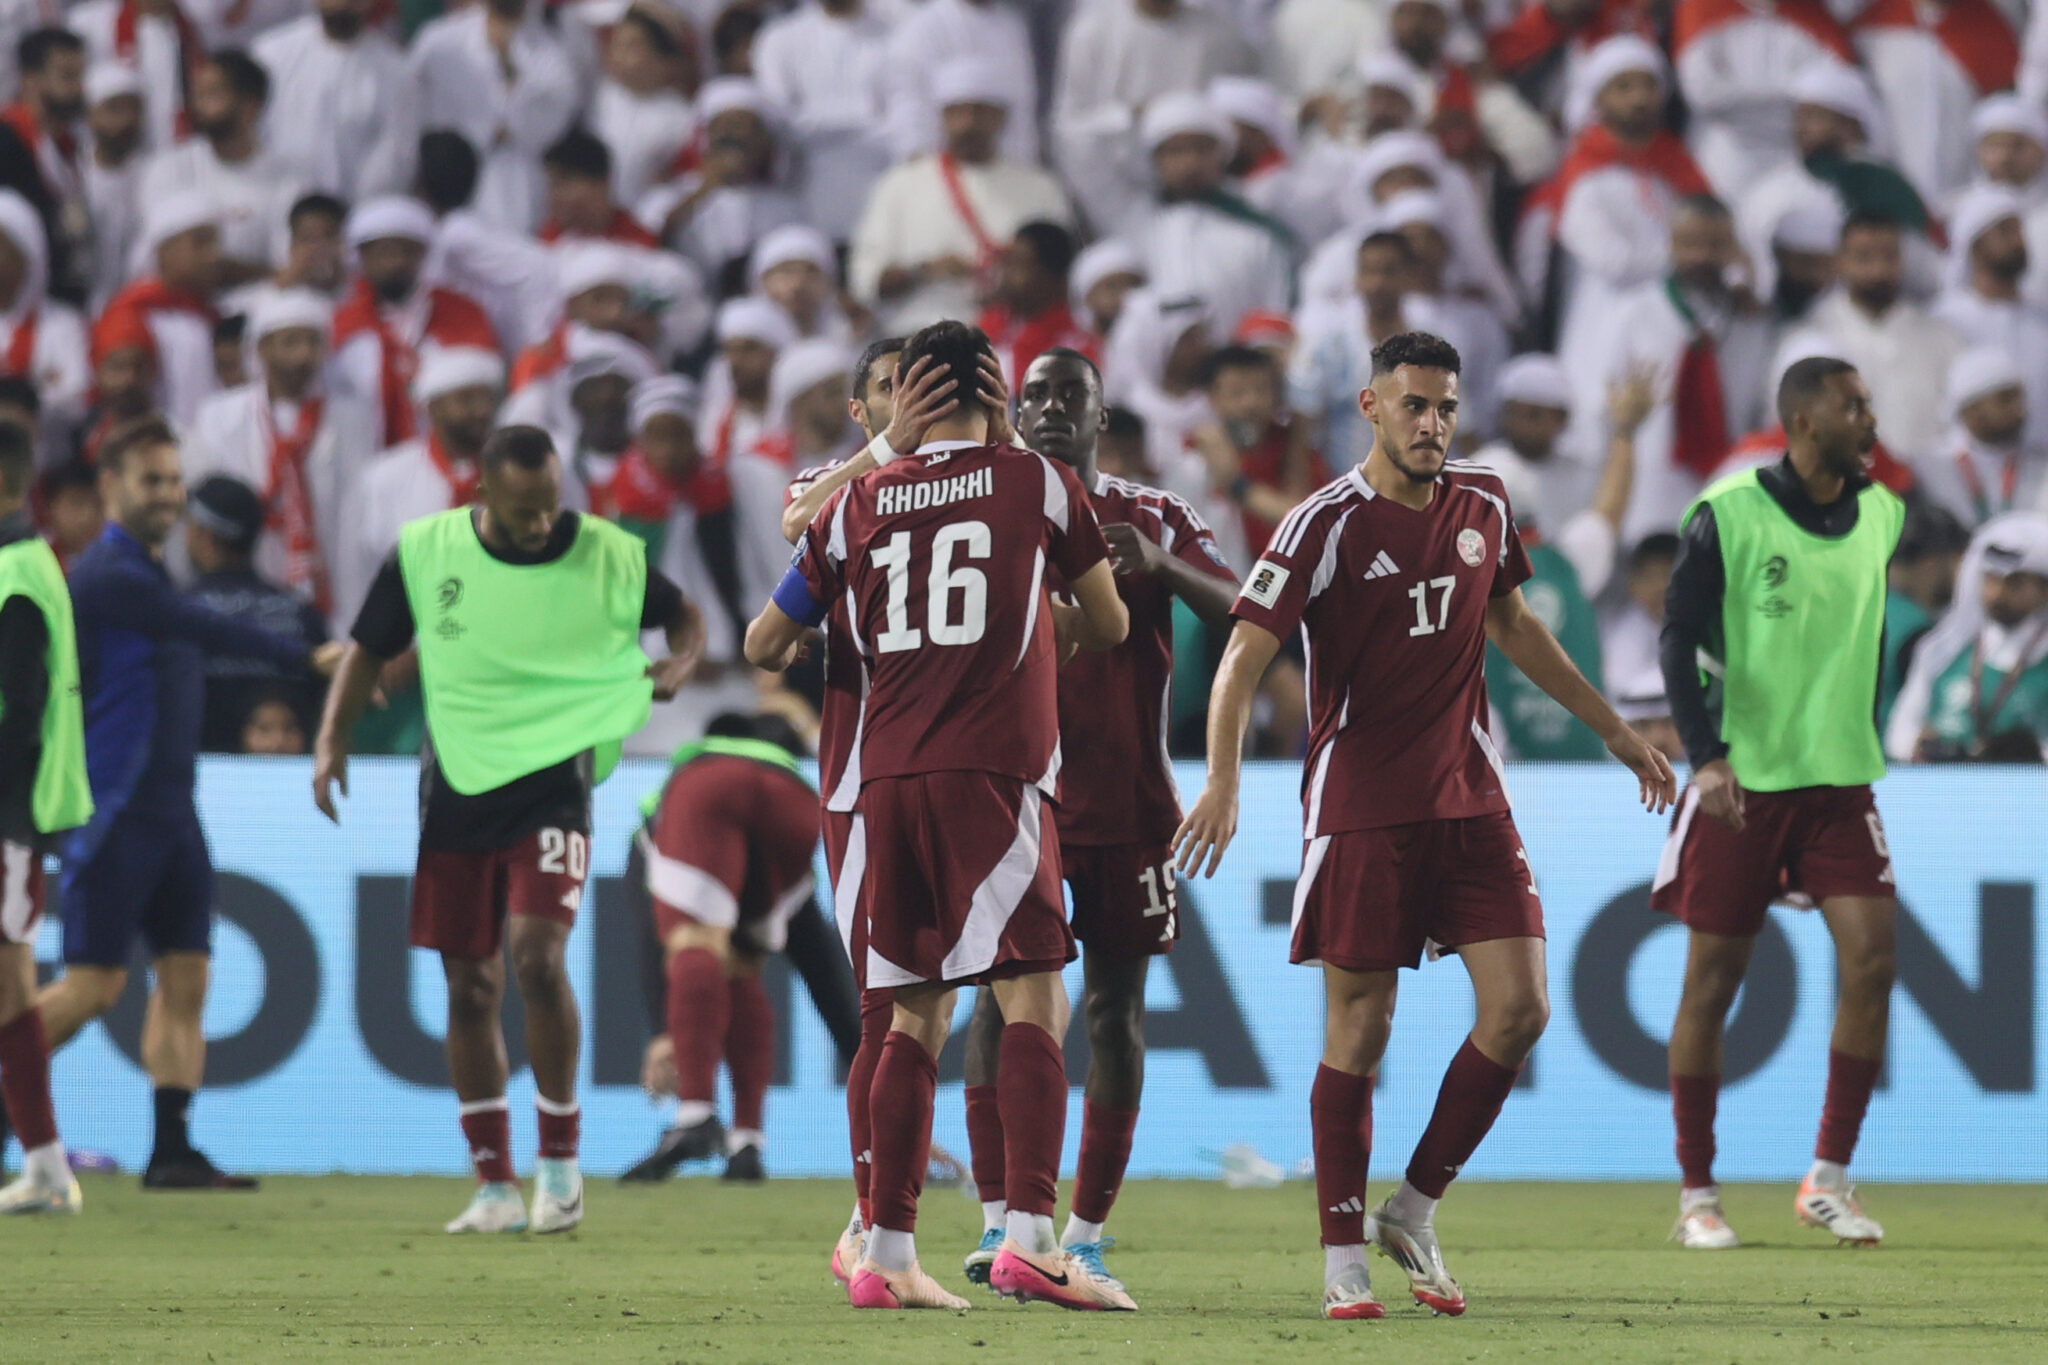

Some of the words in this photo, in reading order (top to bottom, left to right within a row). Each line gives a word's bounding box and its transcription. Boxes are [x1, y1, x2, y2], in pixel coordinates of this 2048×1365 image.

[925, 450, 951, 468] قطر
[876, 466, 994, 516] KHOUKHI
[870, 520, 992, 654] 16
[1408, 575, 1456, 638] 17
[538, 826, 586, 881] 20
